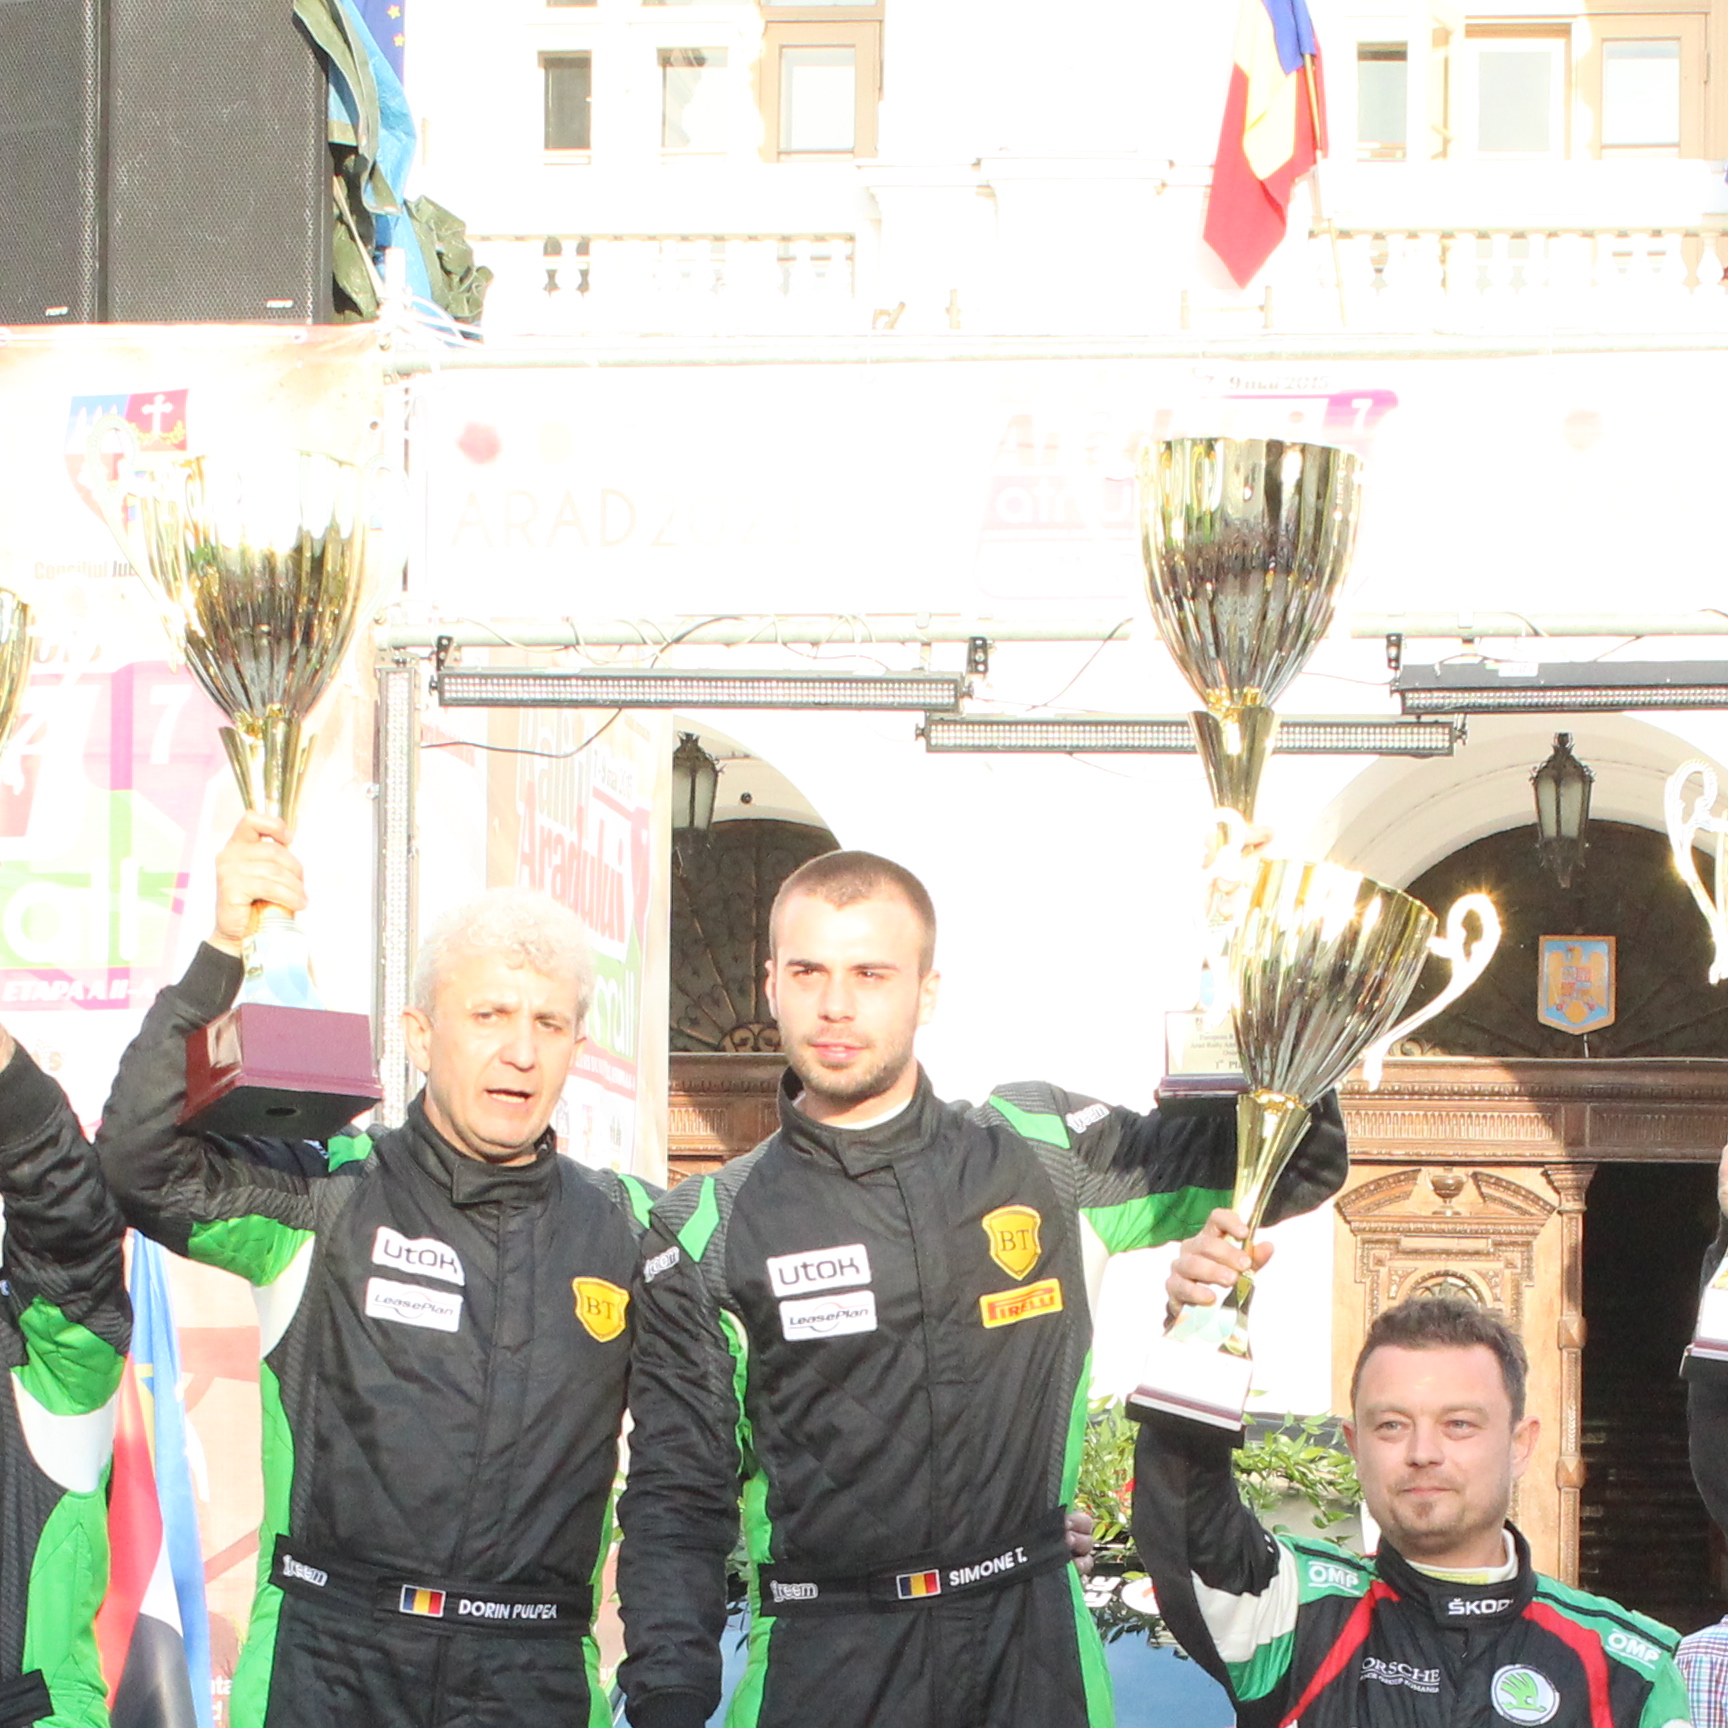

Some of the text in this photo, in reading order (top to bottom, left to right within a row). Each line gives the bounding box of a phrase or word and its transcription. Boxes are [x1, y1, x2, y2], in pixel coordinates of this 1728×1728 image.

[451, 488, 638, 549] ARAD
[999, 1229, 1031, 1253] BT
[373, 1293, 455, 1318] LeasePlan
[586, 1296, 617, 1322] BT
[987, 1286, 1055, 1322] PIRELLI
[789, 1307, 869, 1328] LeasePlan
[948, 1555, 1015, 1588] SIMONE
[1307, 1564, 1360, 1590] OMP
[458, 1597, 557, 1621] DORIN PULPEA
[1607, 1633, 1662, 1664] OMP
